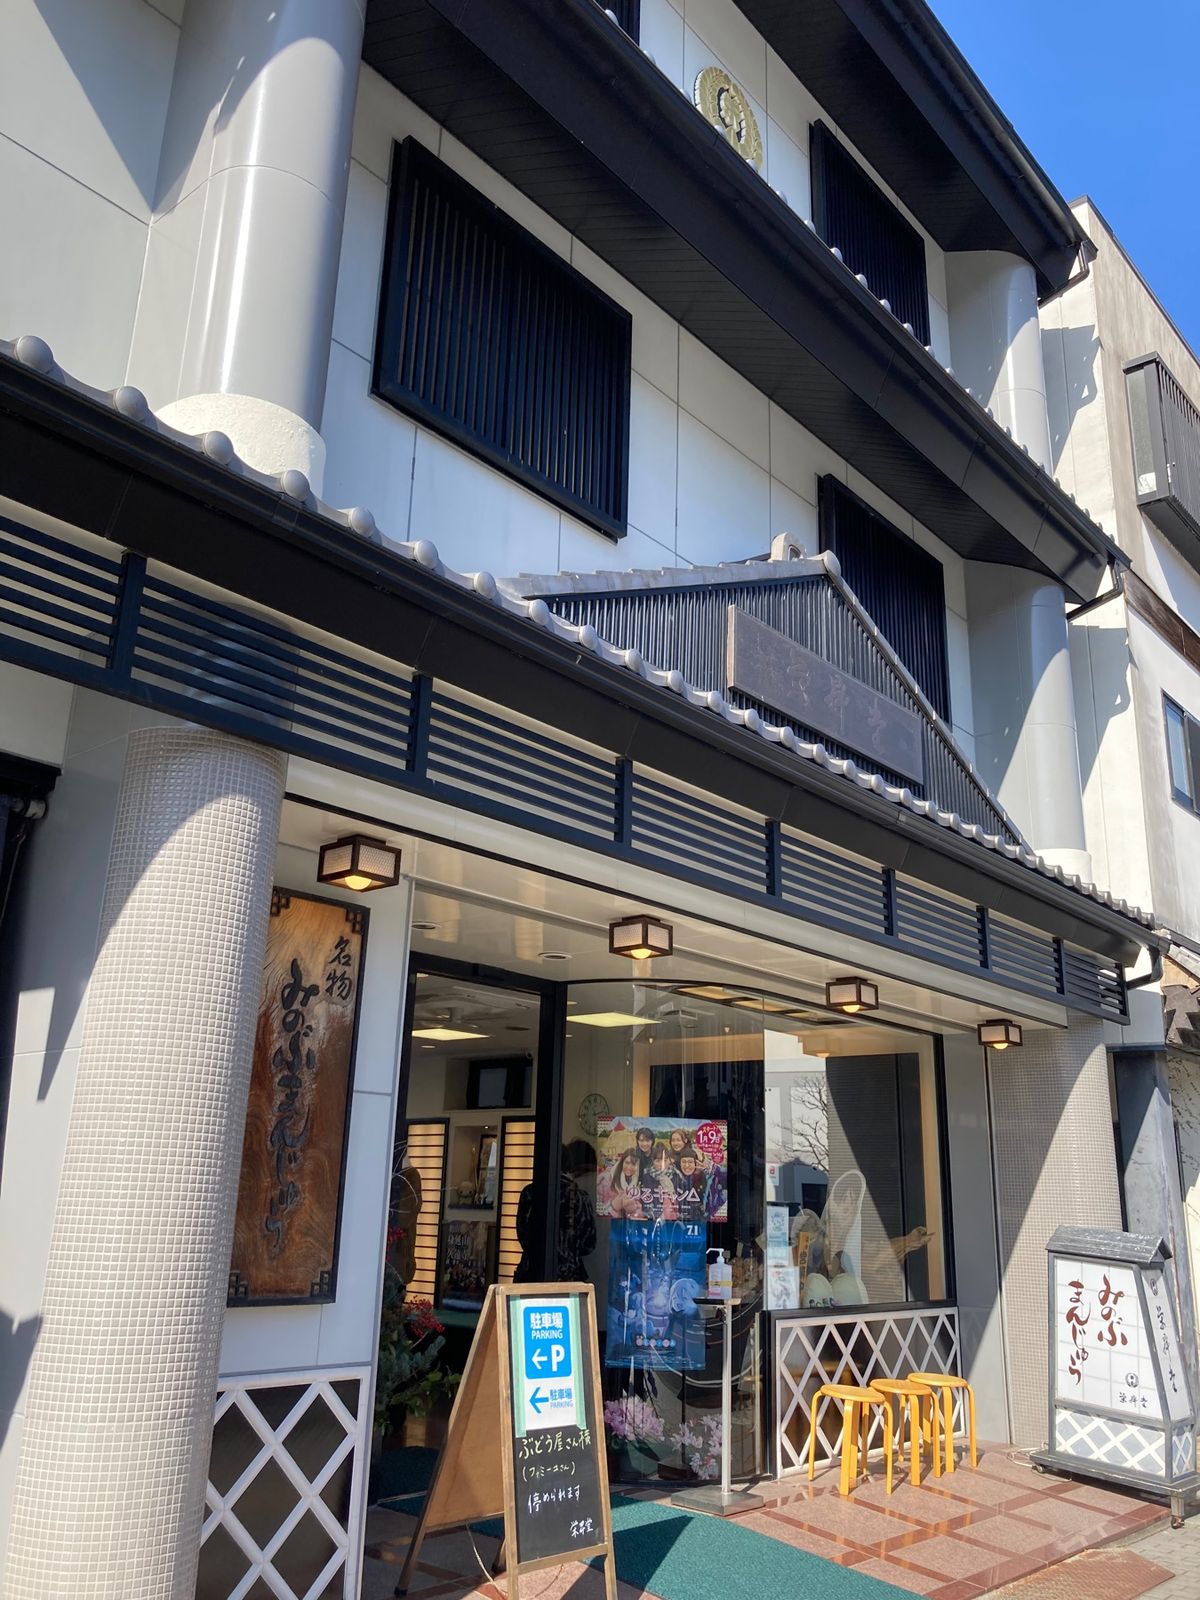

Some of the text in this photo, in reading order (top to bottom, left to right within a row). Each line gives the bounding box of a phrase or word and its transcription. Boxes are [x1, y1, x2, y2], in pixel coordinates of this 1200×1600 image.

[325, 934, 354, 1001] 名物
[264, 957, 320, 1248] みのぶまんじゅう
[530, 1312, 563, 1330] 駐車場
[1097, 1273, 1128, 1347] みのぶ
[531, 1330, 563, 1340] PARKING
[1065, 1278, 1091, 1386] まんじゅう
[551, 1344, 565, 1372] P
[550, 1388, 573, 1401] 駐車場
[550, 1400, 574, 1409] PARKING
[527, 1484, 581, 1514] 停められます
